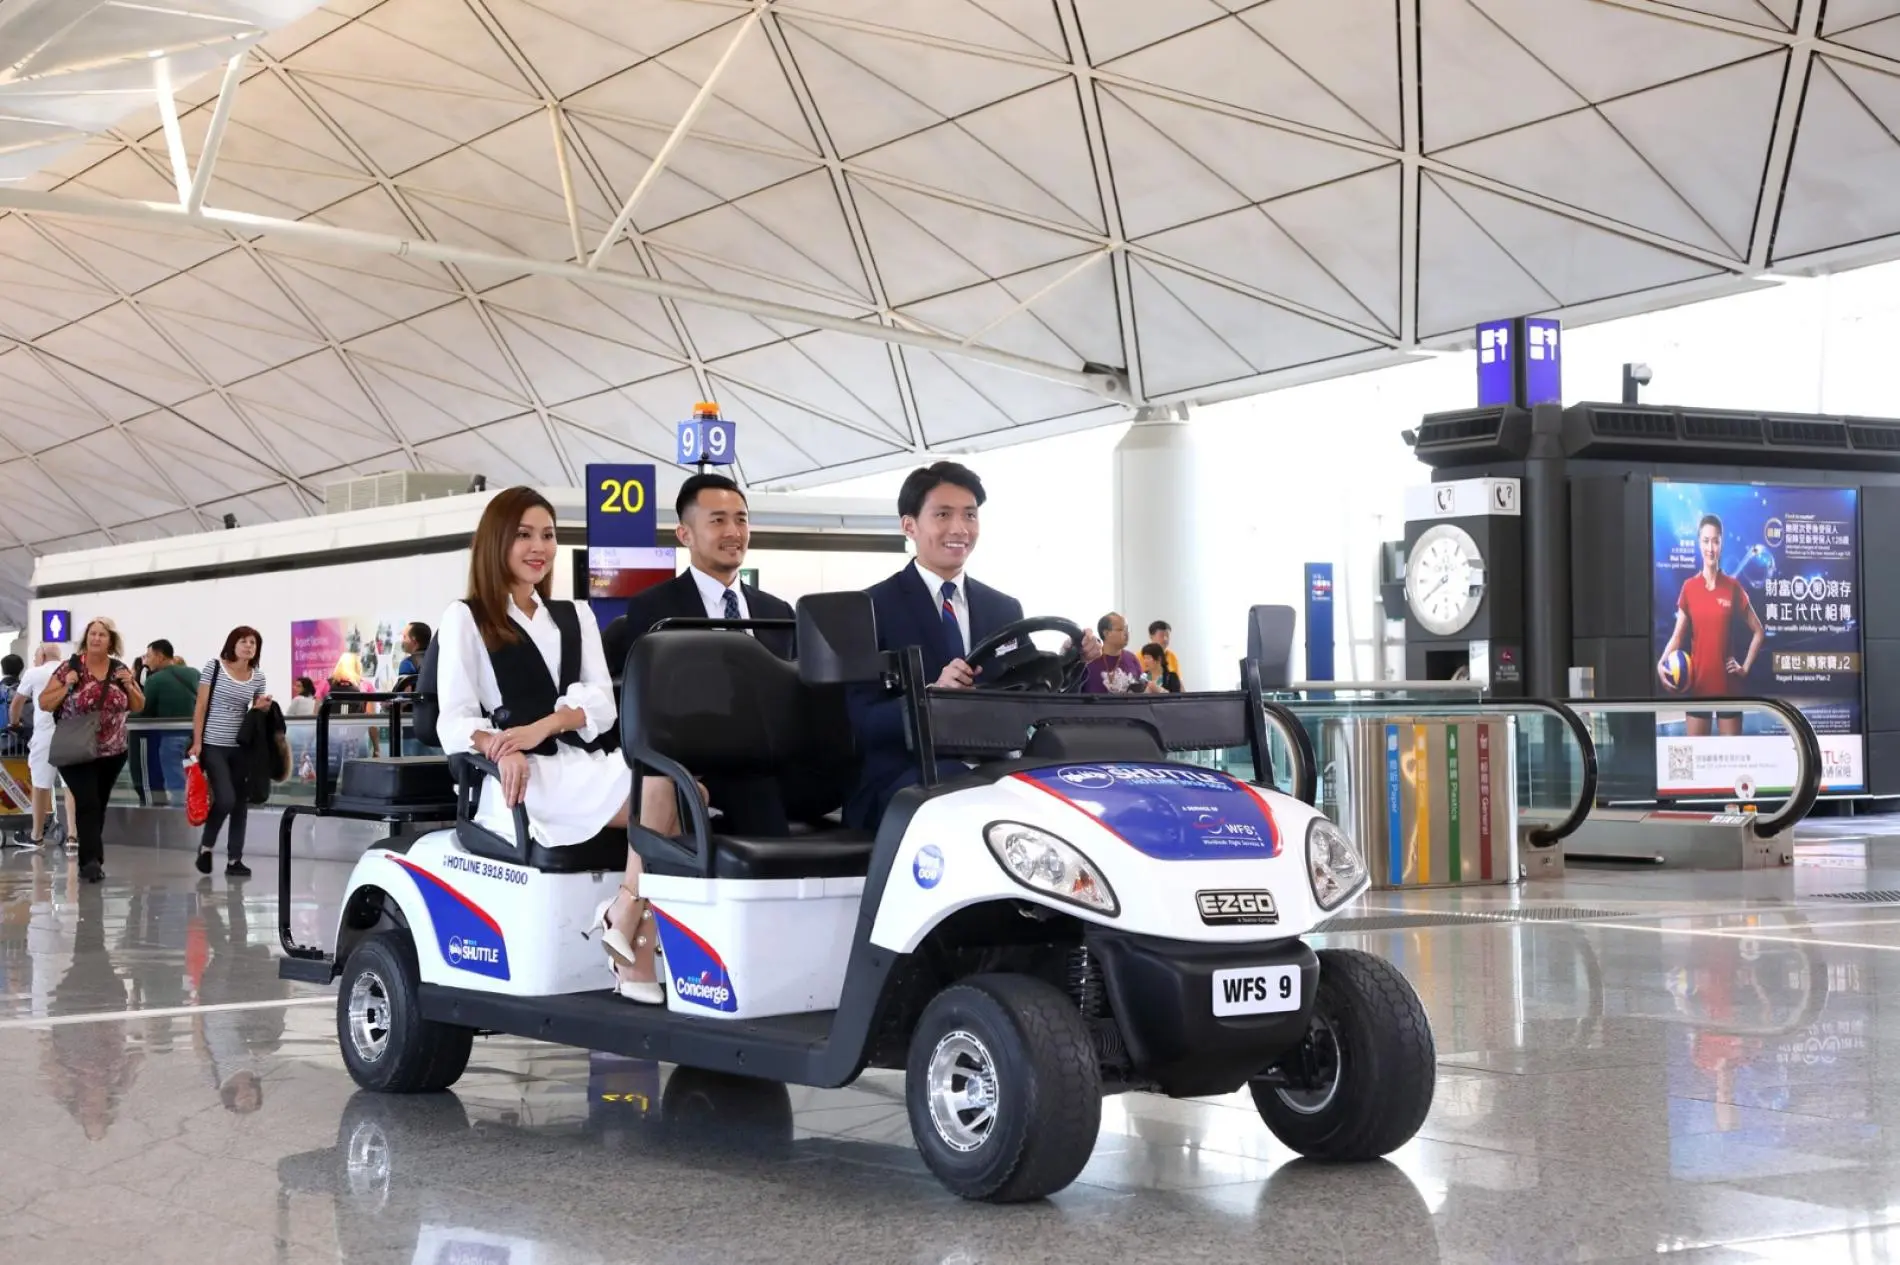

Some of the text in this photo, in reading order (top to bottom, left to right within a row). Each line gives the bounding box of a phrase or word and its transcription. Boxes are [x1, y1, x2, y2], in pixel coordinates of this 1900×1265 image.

[682, 427, 694, 457] 9
[709, 426, 727, 457] 9
[600, 479, 645, 513] 20
[1108, 767, 1220, 784] SHUTTLE
[447, 855, 481, 874] HOTLINE
[482, 863, 503, 880] 3918
[504, 868, 528, 885] 5000
[462, 946, 500, 963] SHUTTLE
[676, 977, 729, 1005] Concierge
[1223, 974, 1292, 1004] WFS 9
